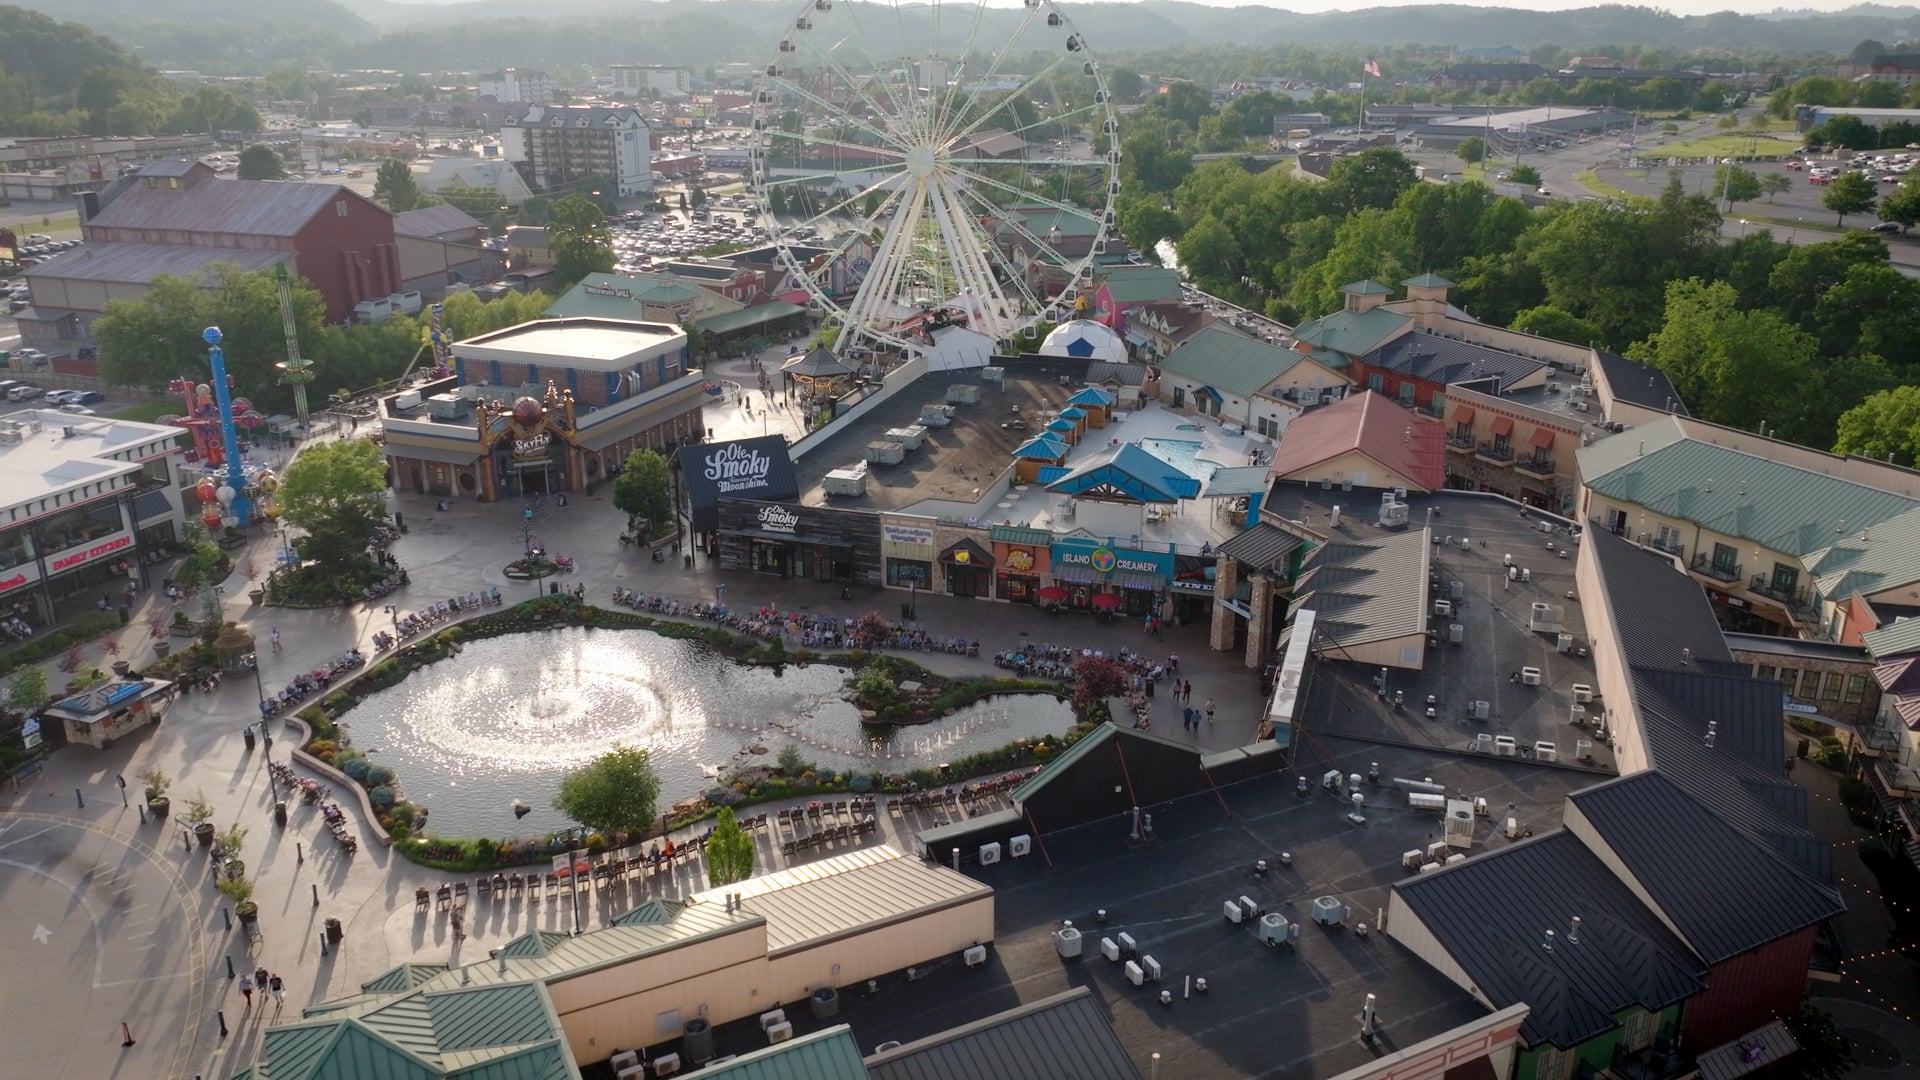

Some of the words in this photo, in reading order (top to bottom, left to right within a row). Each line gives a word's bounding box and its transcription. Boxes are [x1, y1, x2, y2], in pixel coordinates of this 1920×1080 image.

[727, 443, 751, 460] Ole
[704, 449, 770, 480] Smoky
[757, 506, 799, 527] Smoky
[773, 505, 788, 515] Ole
[1062, 553, 1090, 565] ISLAND
[1116, 559, 1158, 572] CREAMERY
